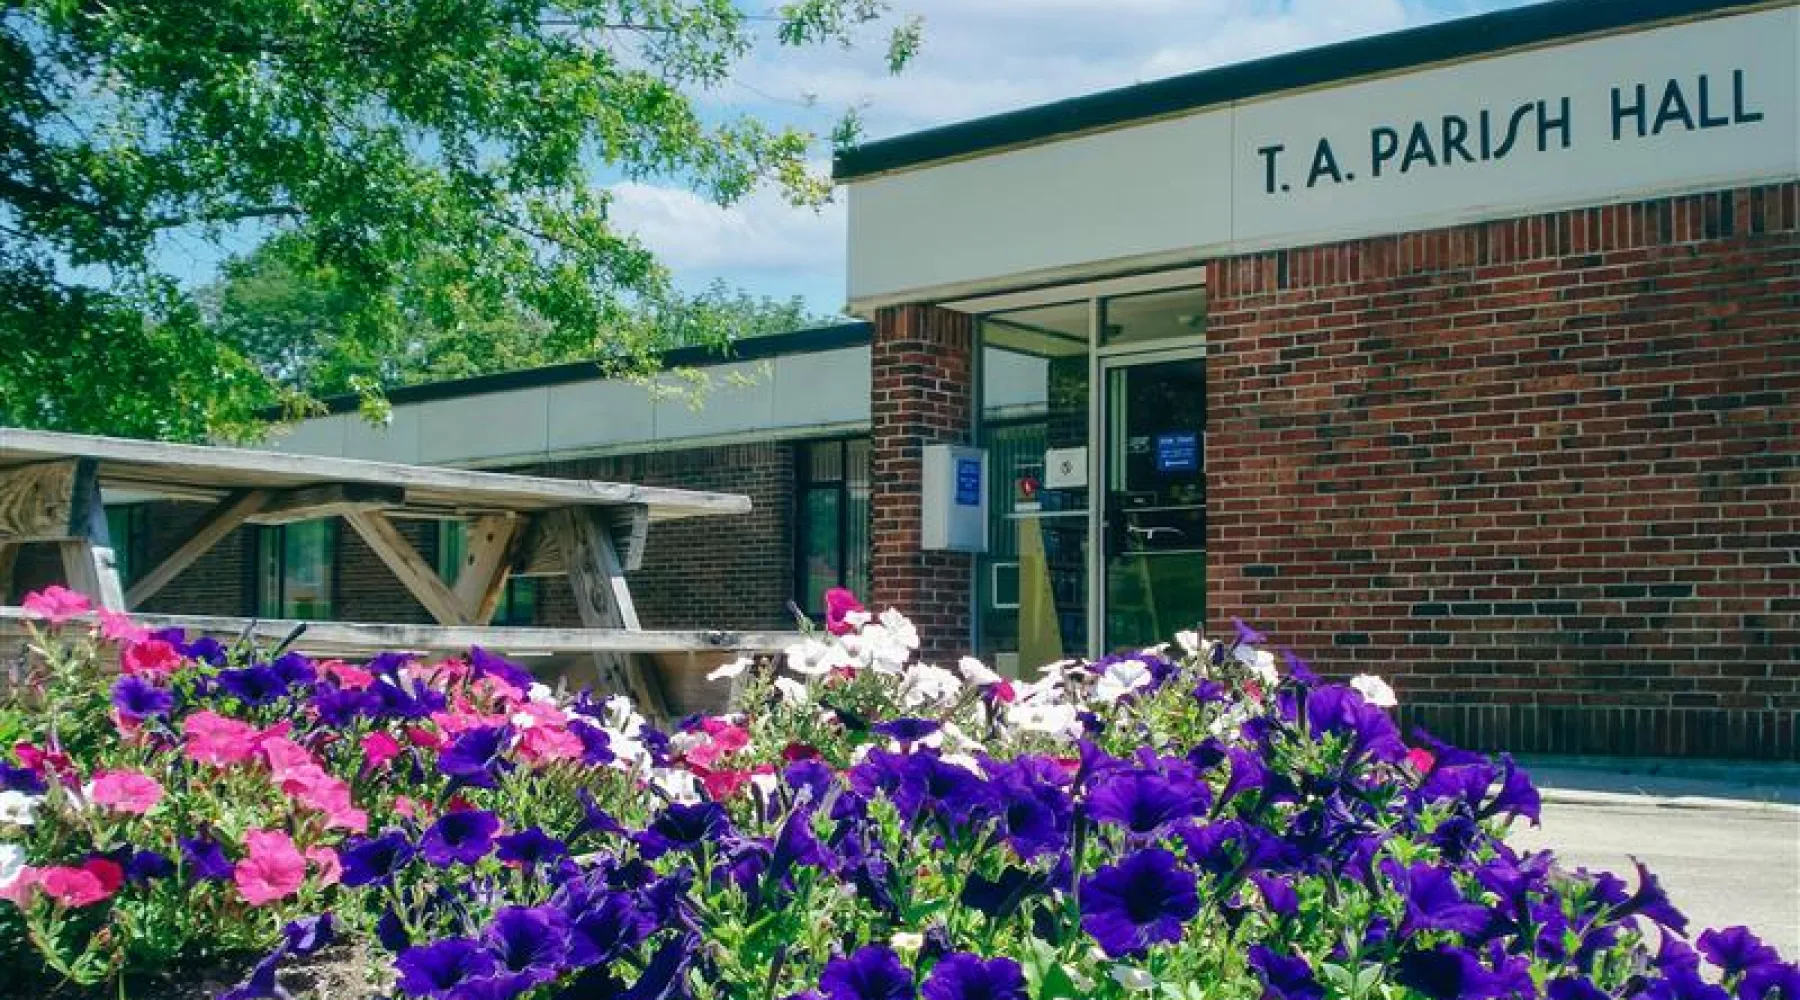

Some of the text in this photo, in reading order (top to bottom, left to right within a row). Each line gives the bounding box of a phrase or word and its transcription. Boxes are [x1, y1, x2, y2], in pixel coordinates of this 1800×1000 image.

[1258, 69, 1765, 194] T. A. PARISH HALL
